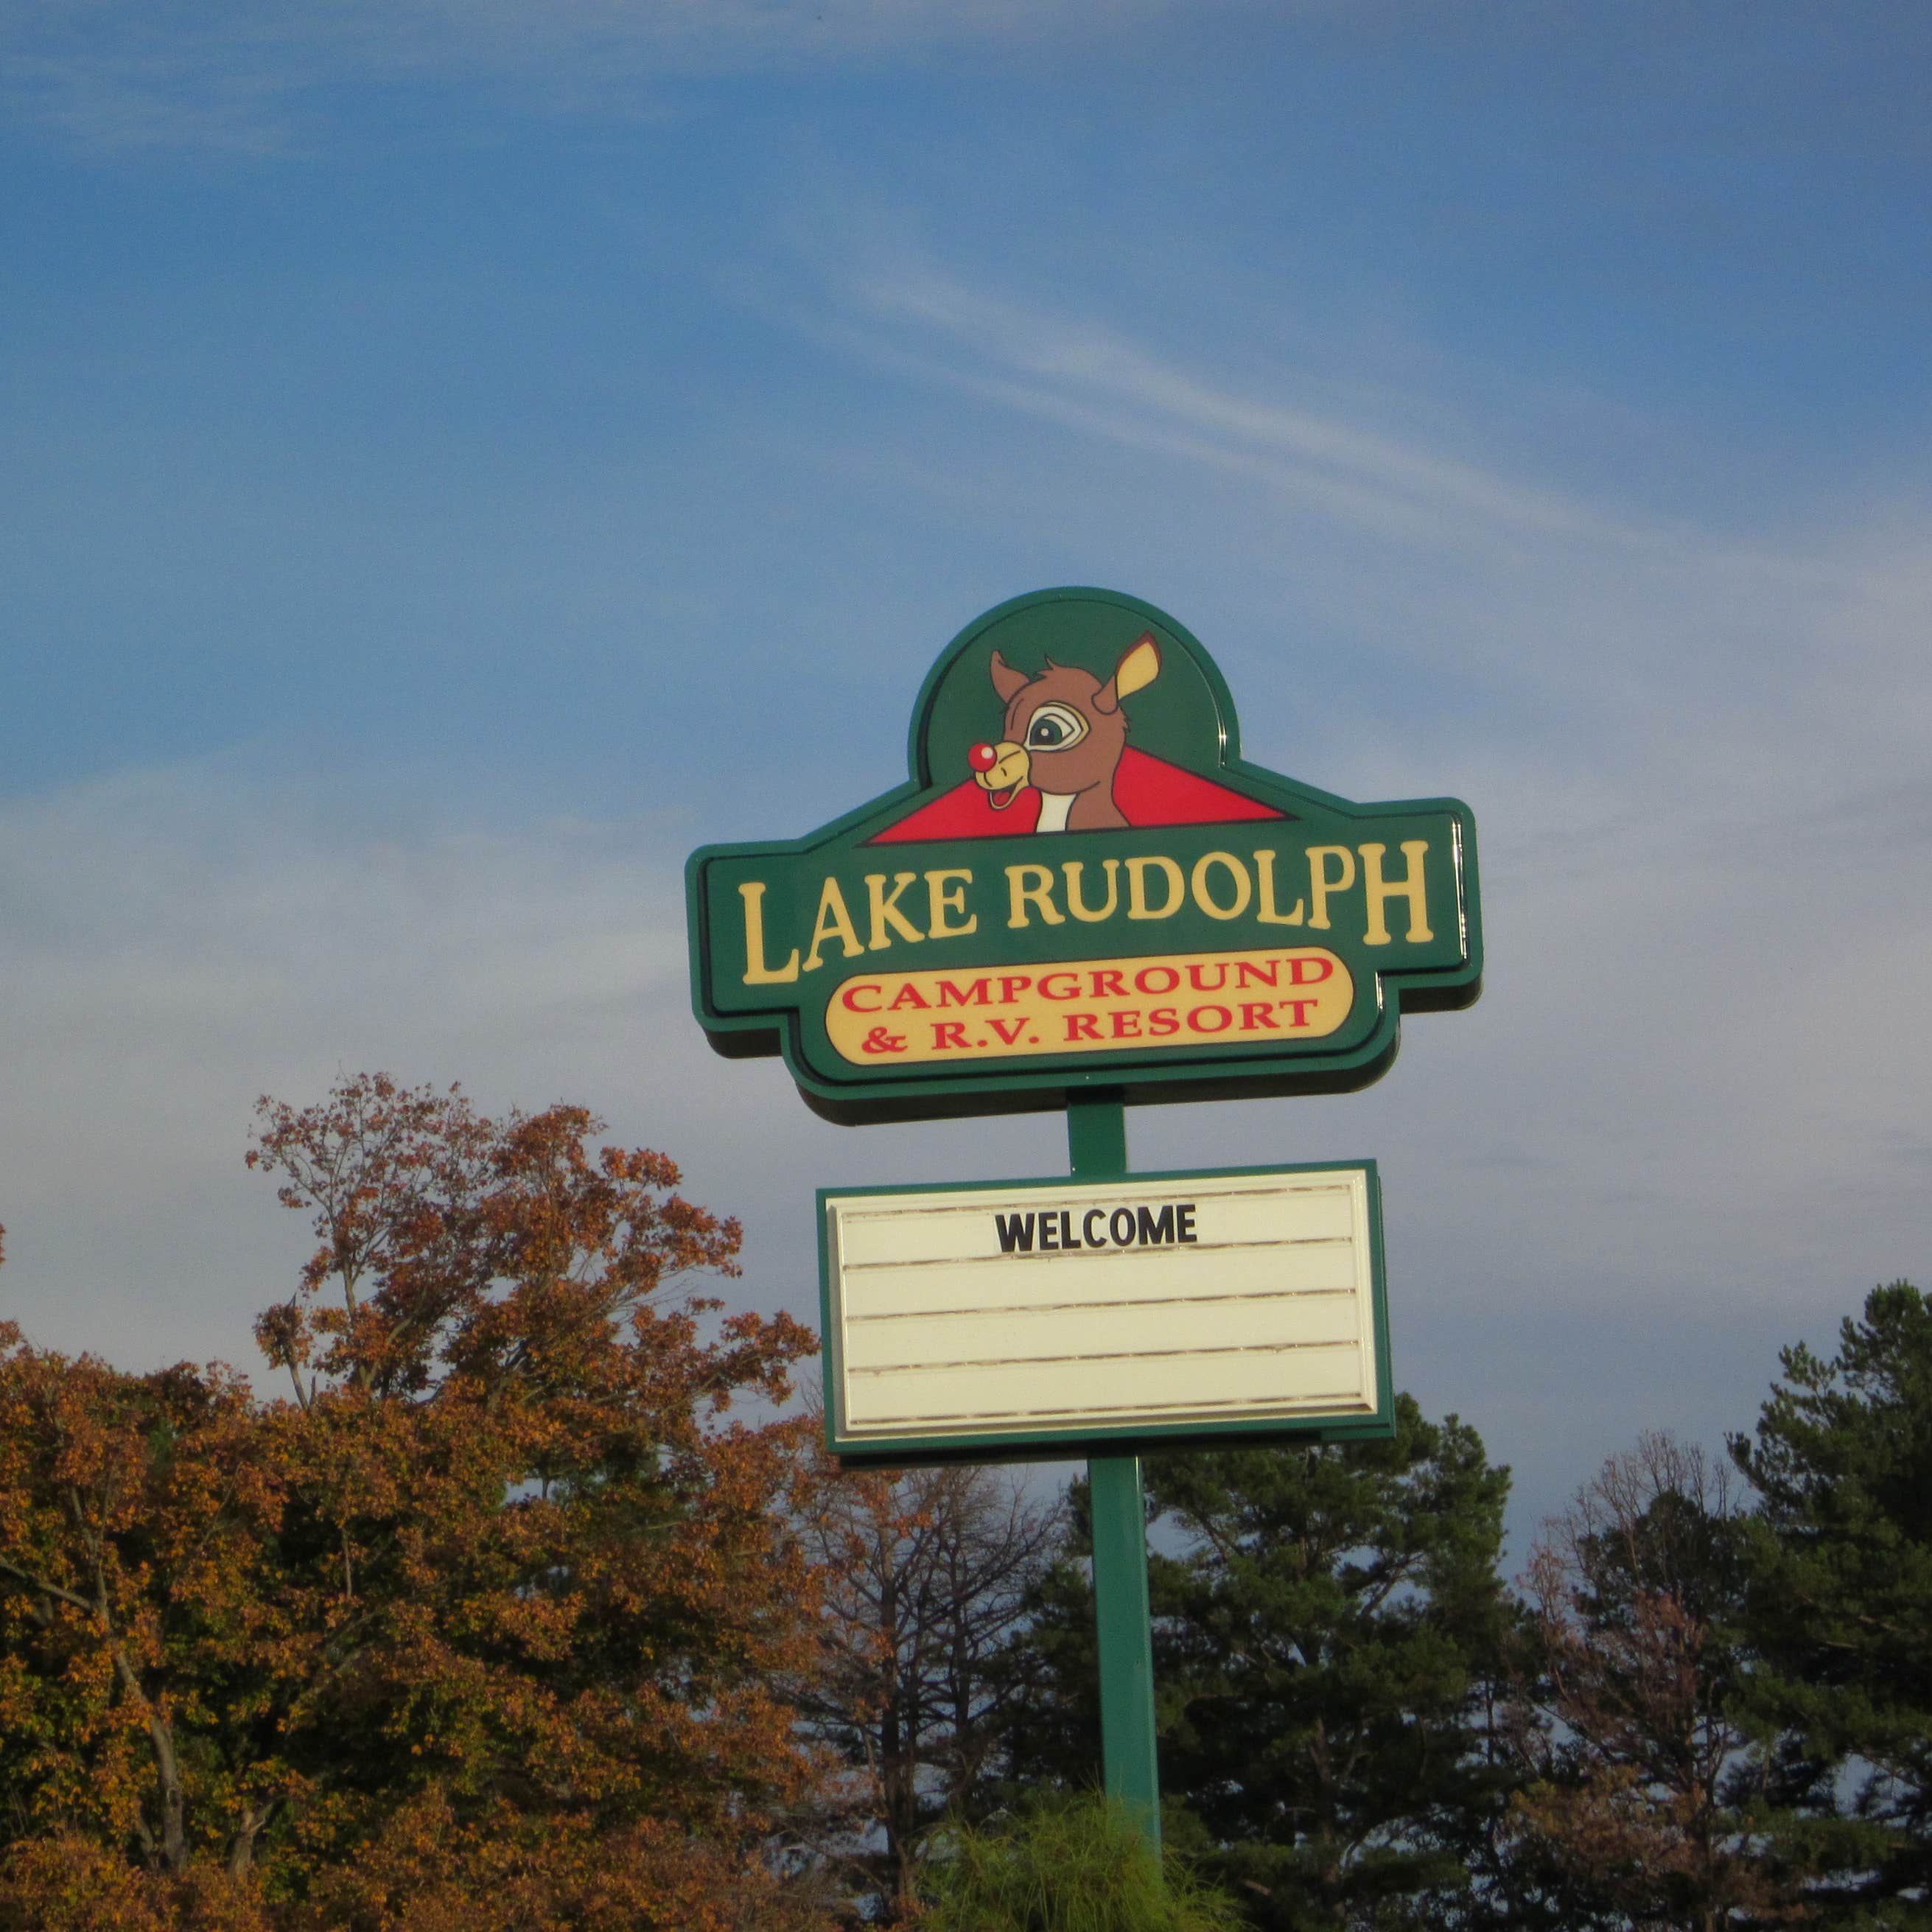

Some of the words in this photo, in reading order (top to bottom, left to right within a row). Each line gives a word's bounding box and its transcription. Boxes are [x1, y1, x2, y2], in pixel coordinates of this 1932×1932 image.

[738, 868, 977, 984] LAKE
[1005, 840, 1434, 945] RUDOLPH
[841, 956, 1334, 1012] CAMPGROUND
[861, 1026, 908, 1054] &
[930, 1017, 1039, 1050] R.V.
[1063, 999, 1319, 1041] RESORT
[995, 1204, 1197, 1253] WELCOME
